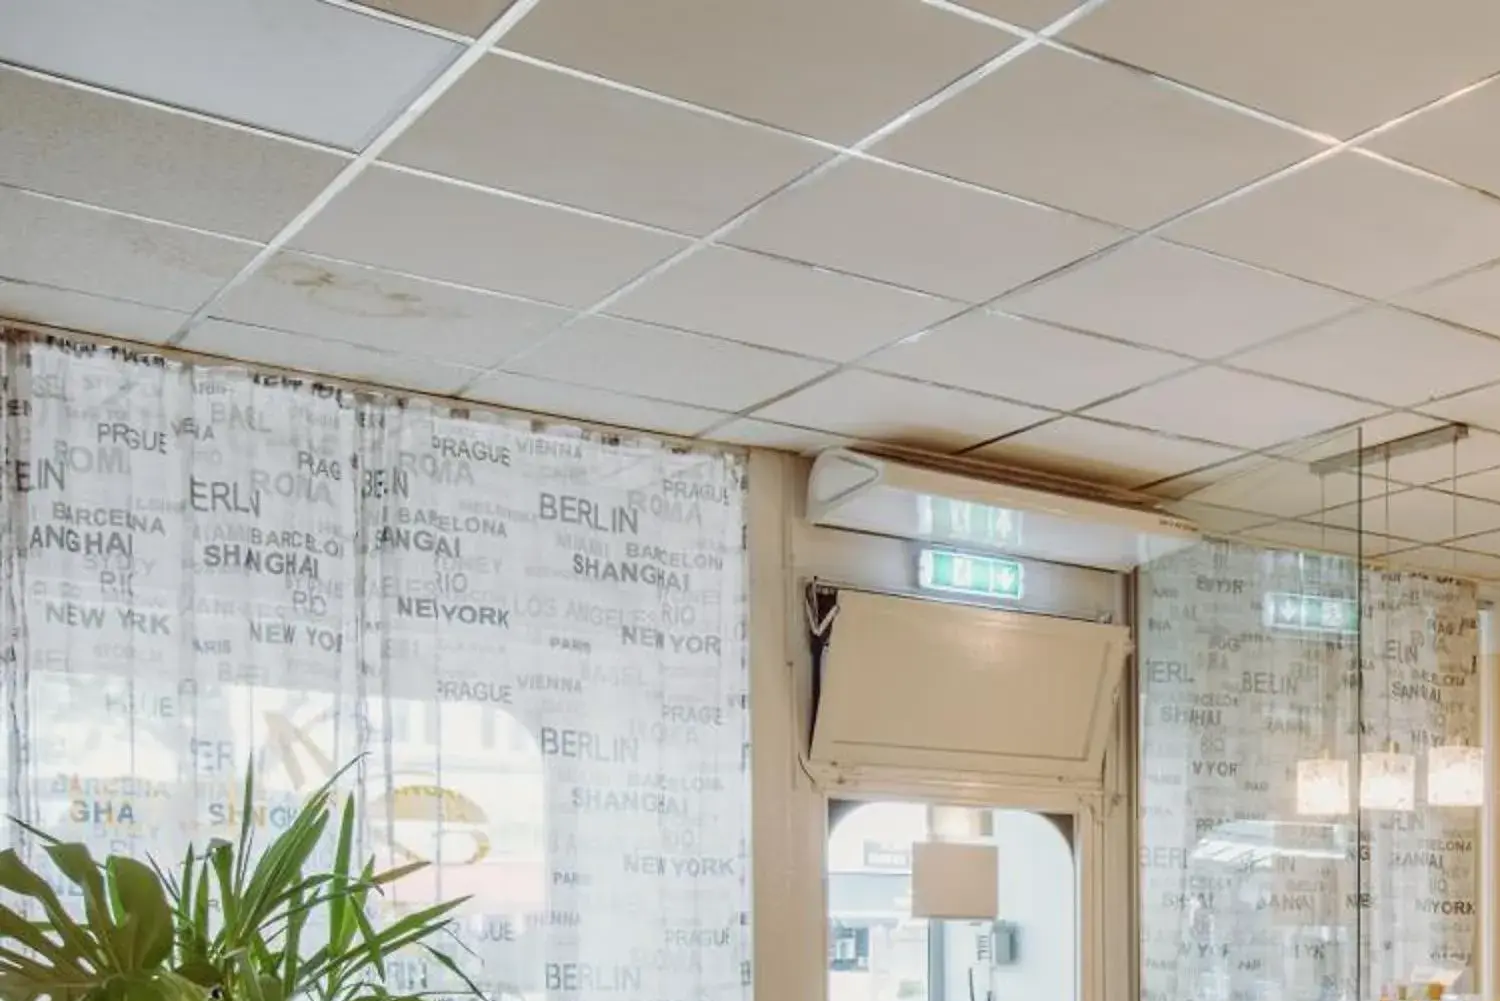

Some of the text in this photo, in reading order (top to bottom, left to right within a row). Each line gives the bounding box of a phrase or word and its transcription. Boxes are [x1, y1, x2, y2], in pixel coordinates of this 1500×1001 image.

[540, 492, 638, 535] BERLIN
[46, 601, 105, 629] NEW
[669, 634, 722, 657] YOR
[541, 726, 640, 764] BERLIN
[545, 962, 642, 992] BERLIN
